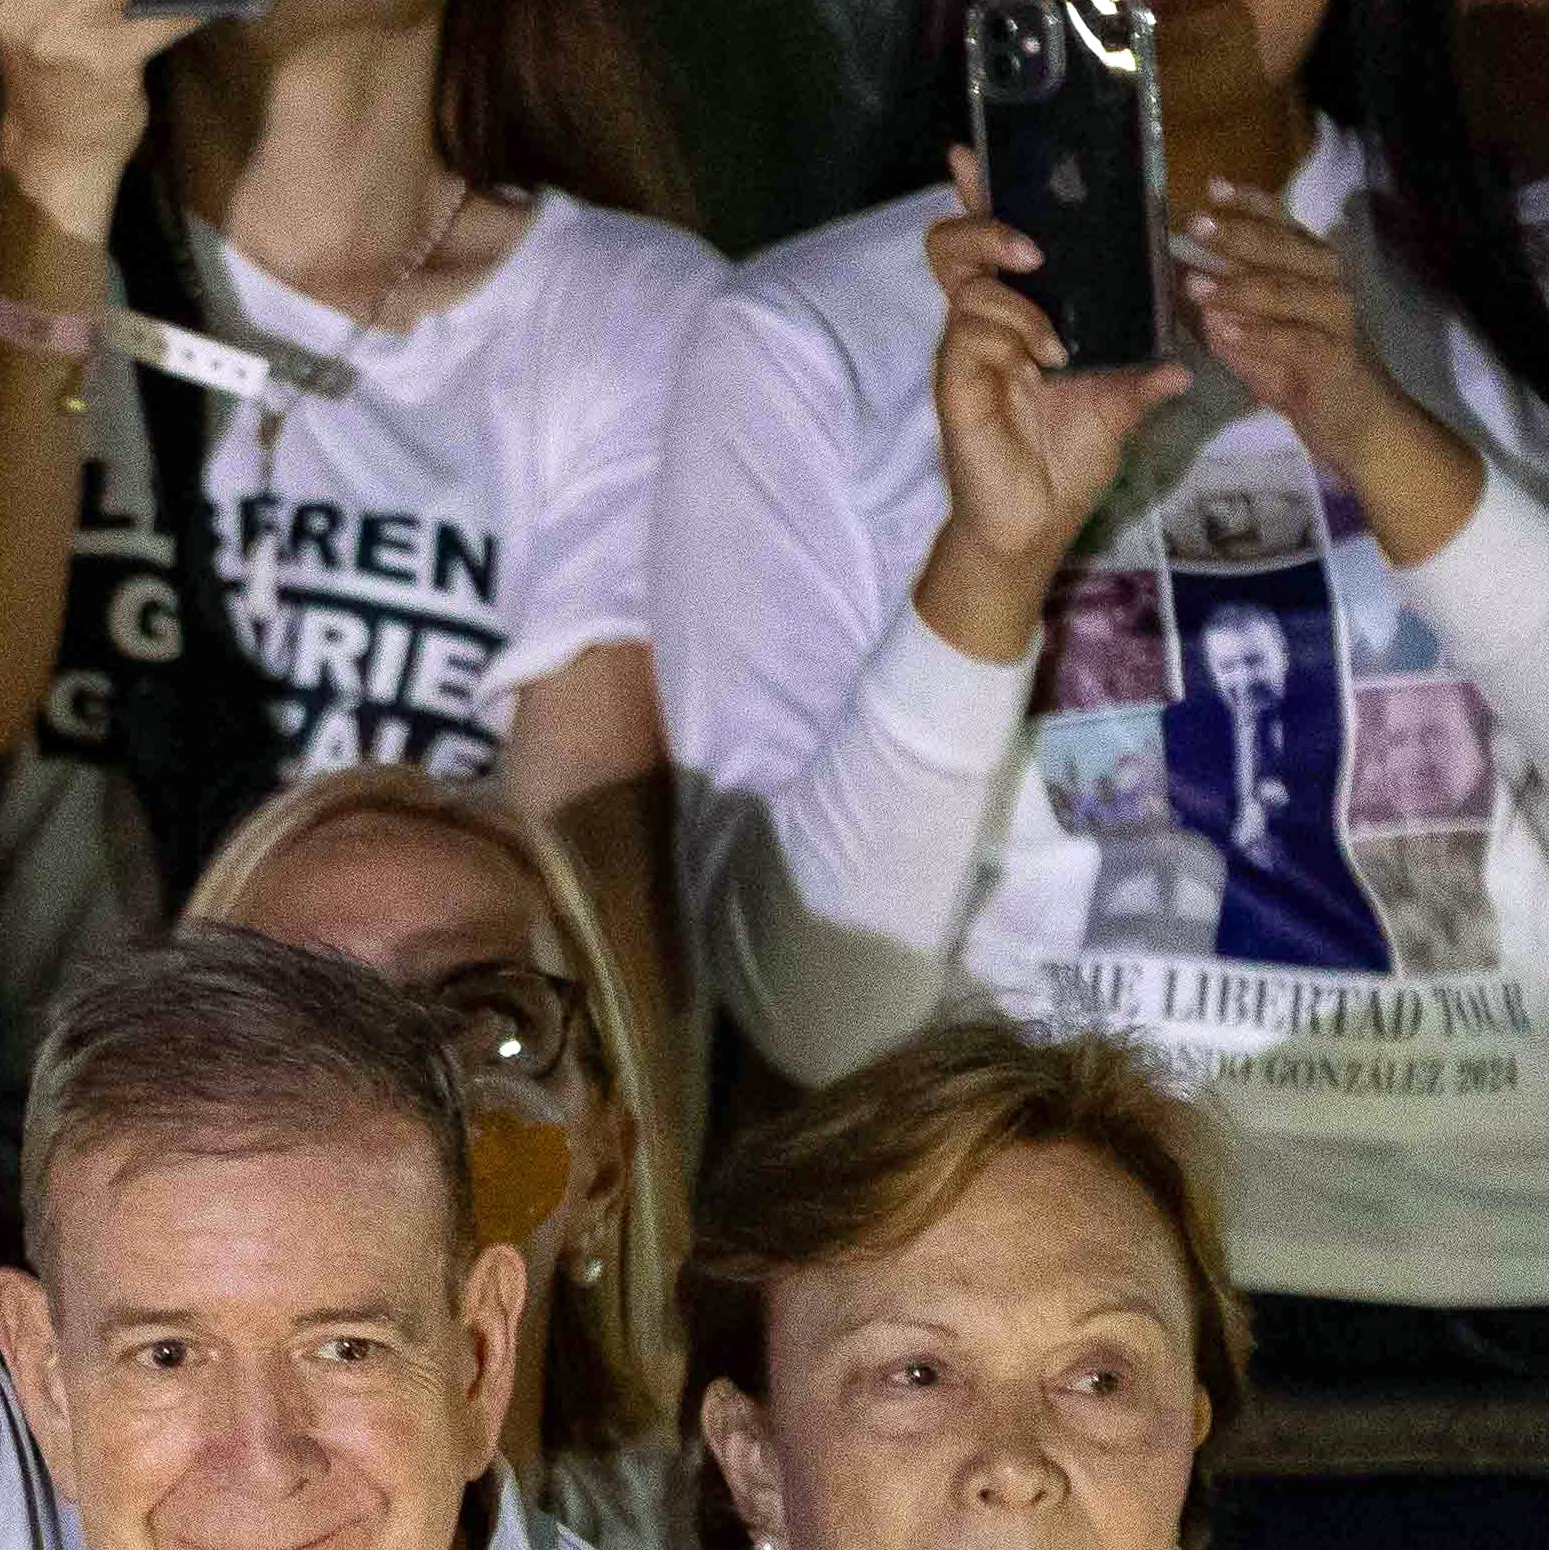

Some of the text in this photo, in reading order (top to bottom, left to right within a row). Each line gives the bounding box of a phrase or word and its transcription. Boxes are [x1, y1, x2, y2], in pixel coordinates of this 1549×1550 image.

[1163, 967, 1424, 1040] LIBERTAD
[1431, 977, 1533, 1038] TOUR
[1457, 1055, 1518, 1094] 2024
